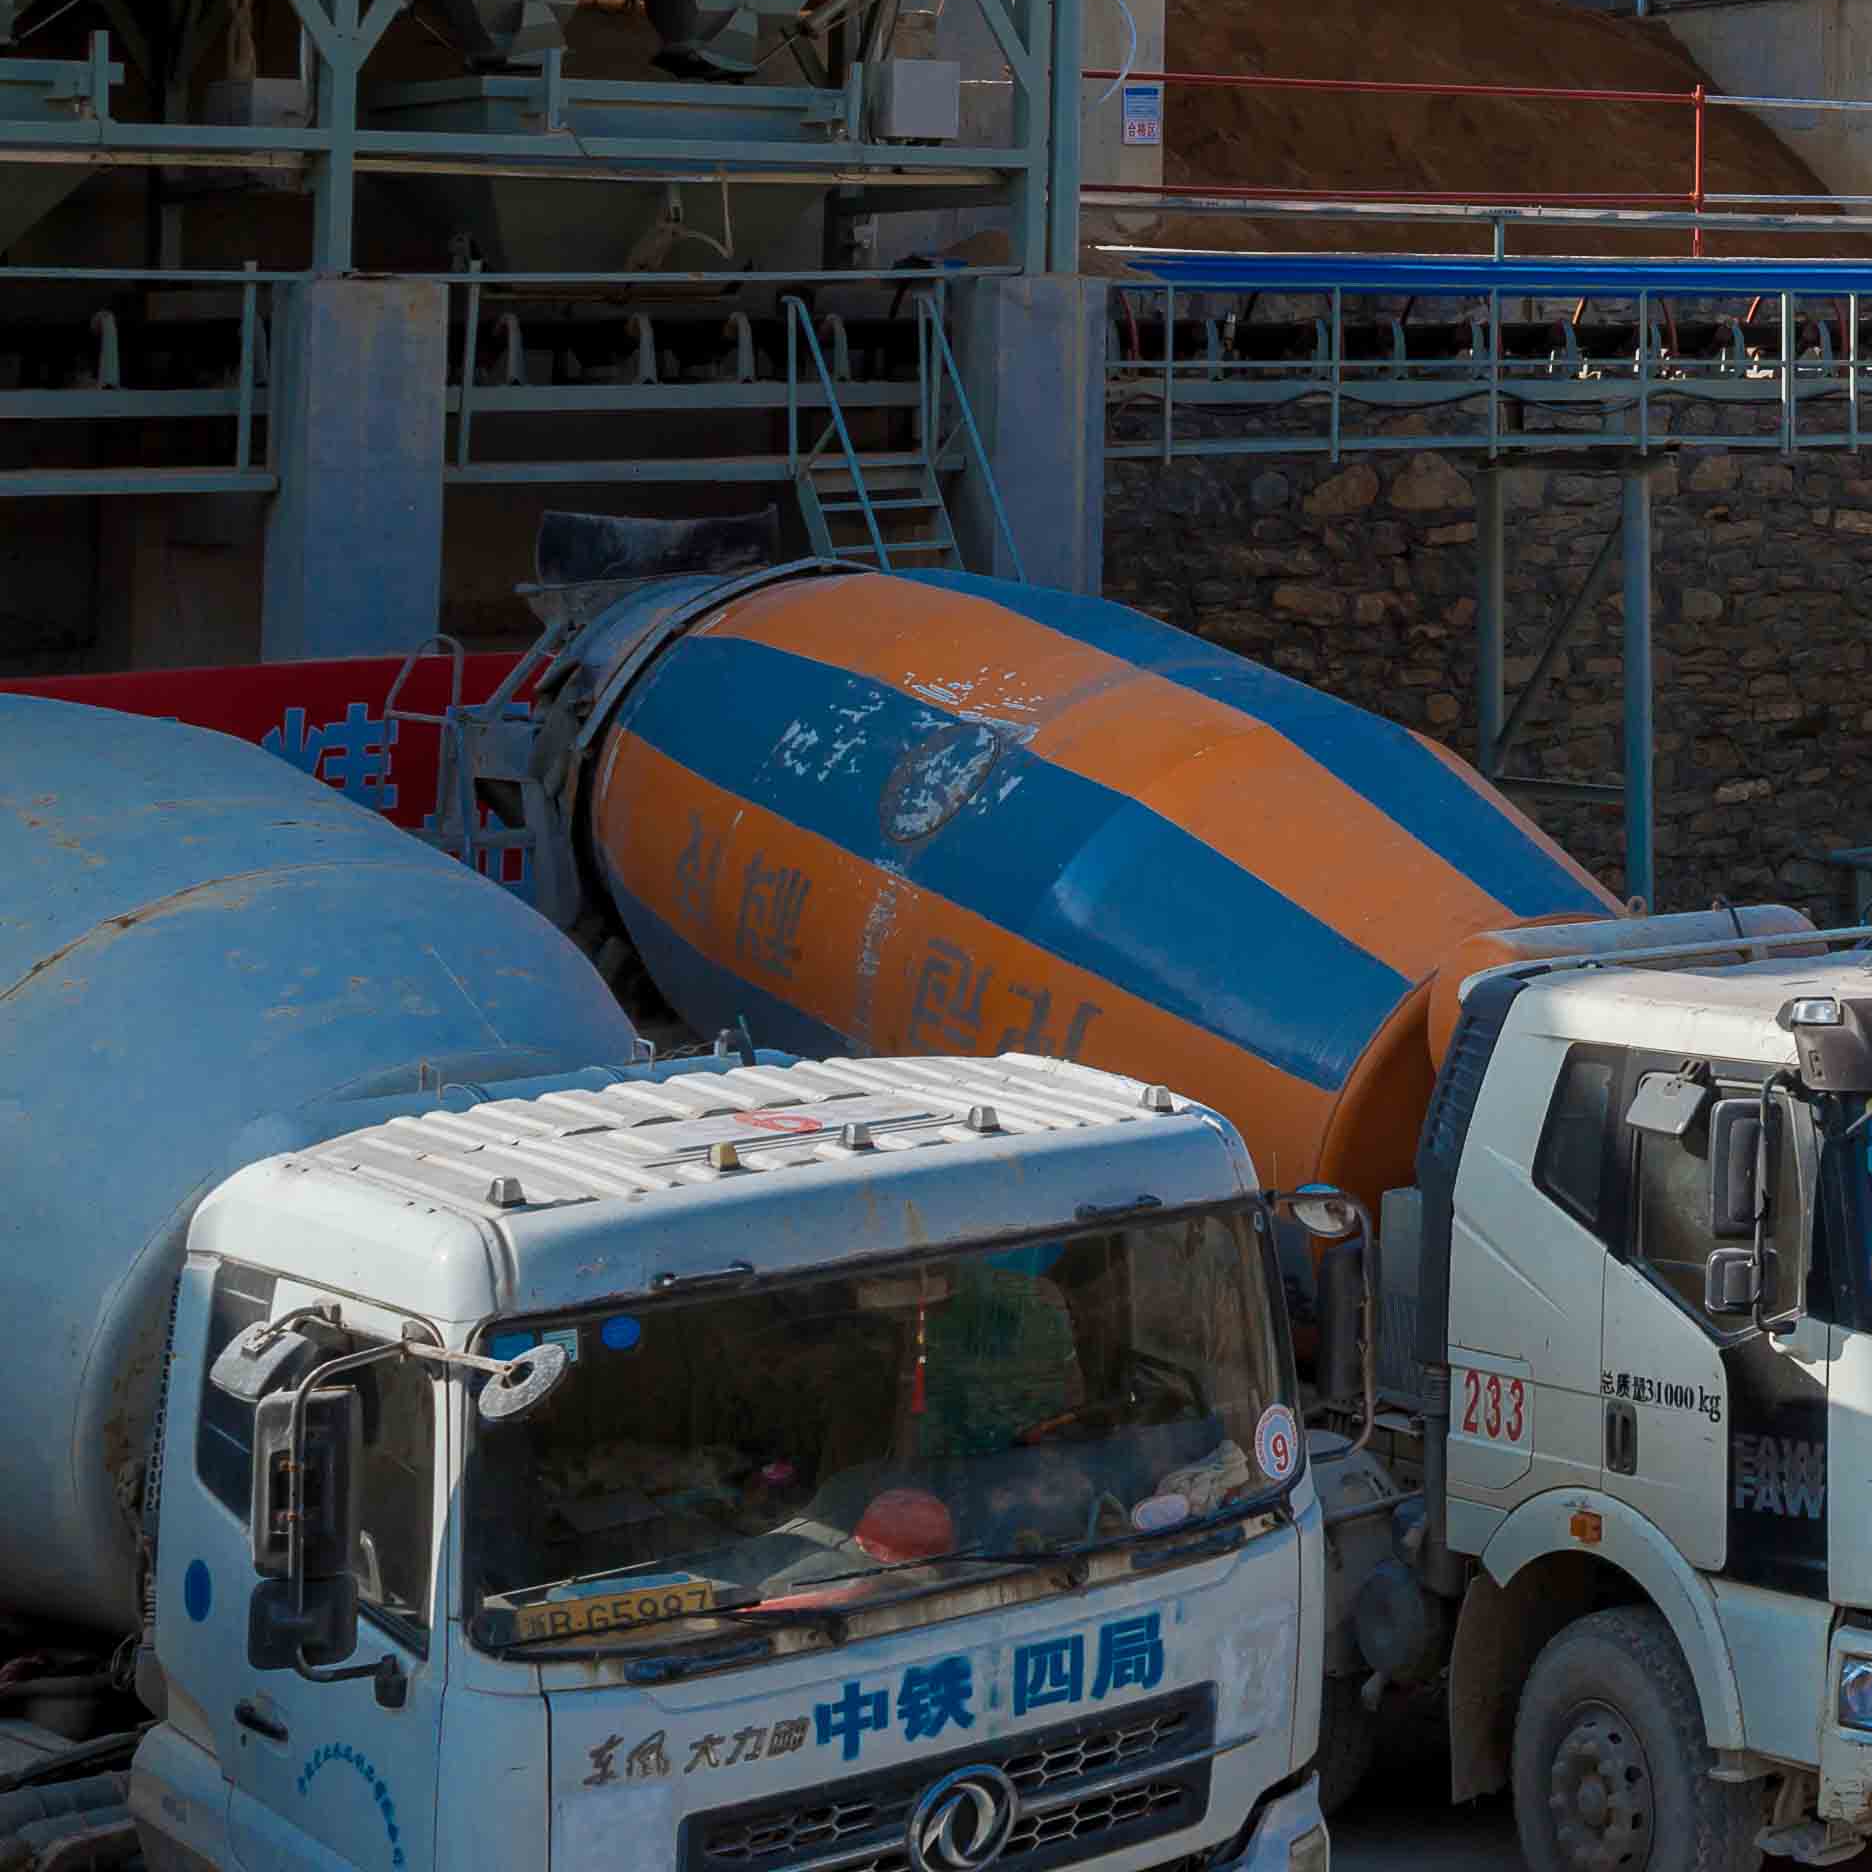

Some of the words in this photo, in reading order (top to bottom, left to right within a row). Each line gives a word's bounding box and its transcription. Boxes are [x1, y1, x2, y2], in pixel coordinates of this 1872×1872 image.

[1463, 1369, 1525, 1442] 233
[1600, 1368, 1694, 1411] 总质量31000
[1698, 1385, 1722, 1423] kg
[1271, 1432, 1289, 1472] 9
[1733, 1479, 1826, 1519] FAW
[813, 1655, 975, 1761] 中铁
[1012, 1612, 1164, 1716] 四局
